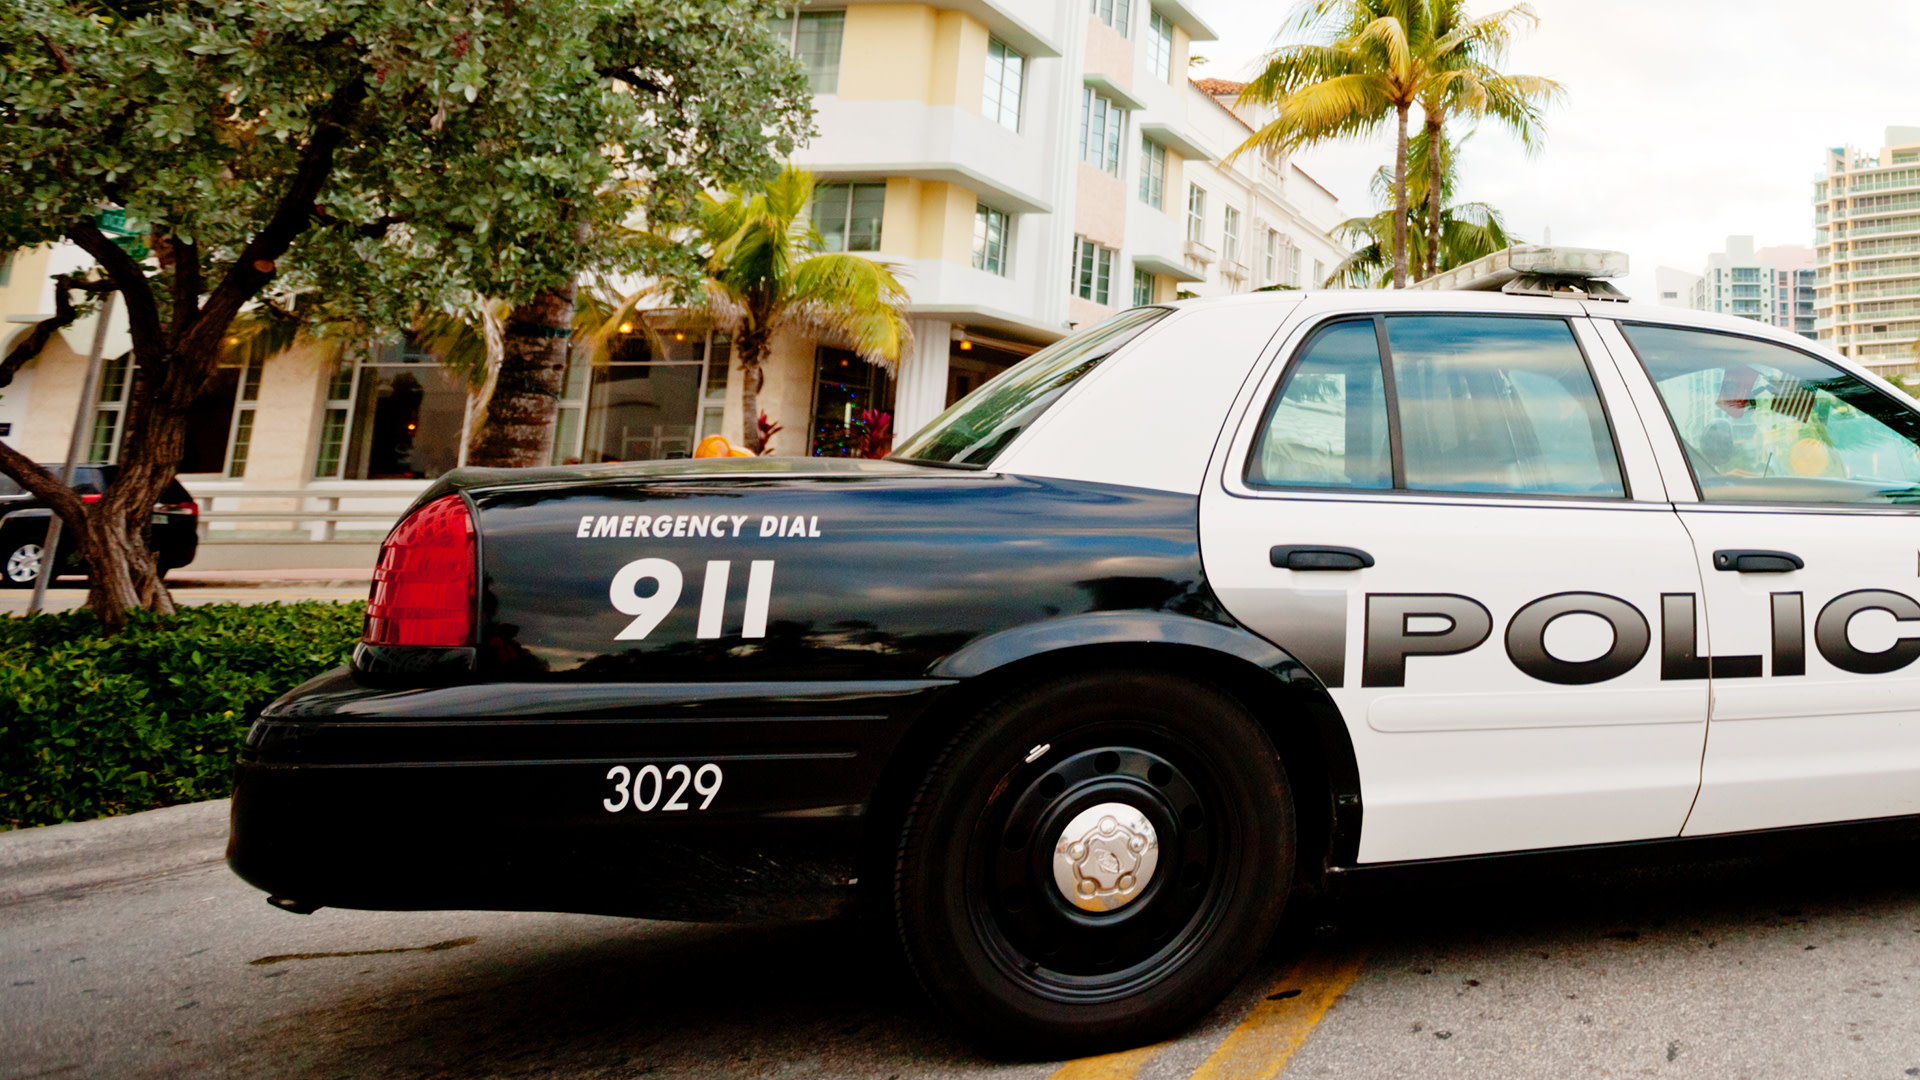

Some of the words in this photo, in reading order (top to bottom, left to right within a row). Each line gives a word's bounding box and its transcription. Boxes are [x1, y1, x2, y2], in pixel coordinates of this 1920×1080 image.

[577, 515, 748, 537] EMERGENCY
[760, 515, 820, 537] DIAL
[610, 558, 774, 640] 911
[603, 763, 723, 812] 3029
